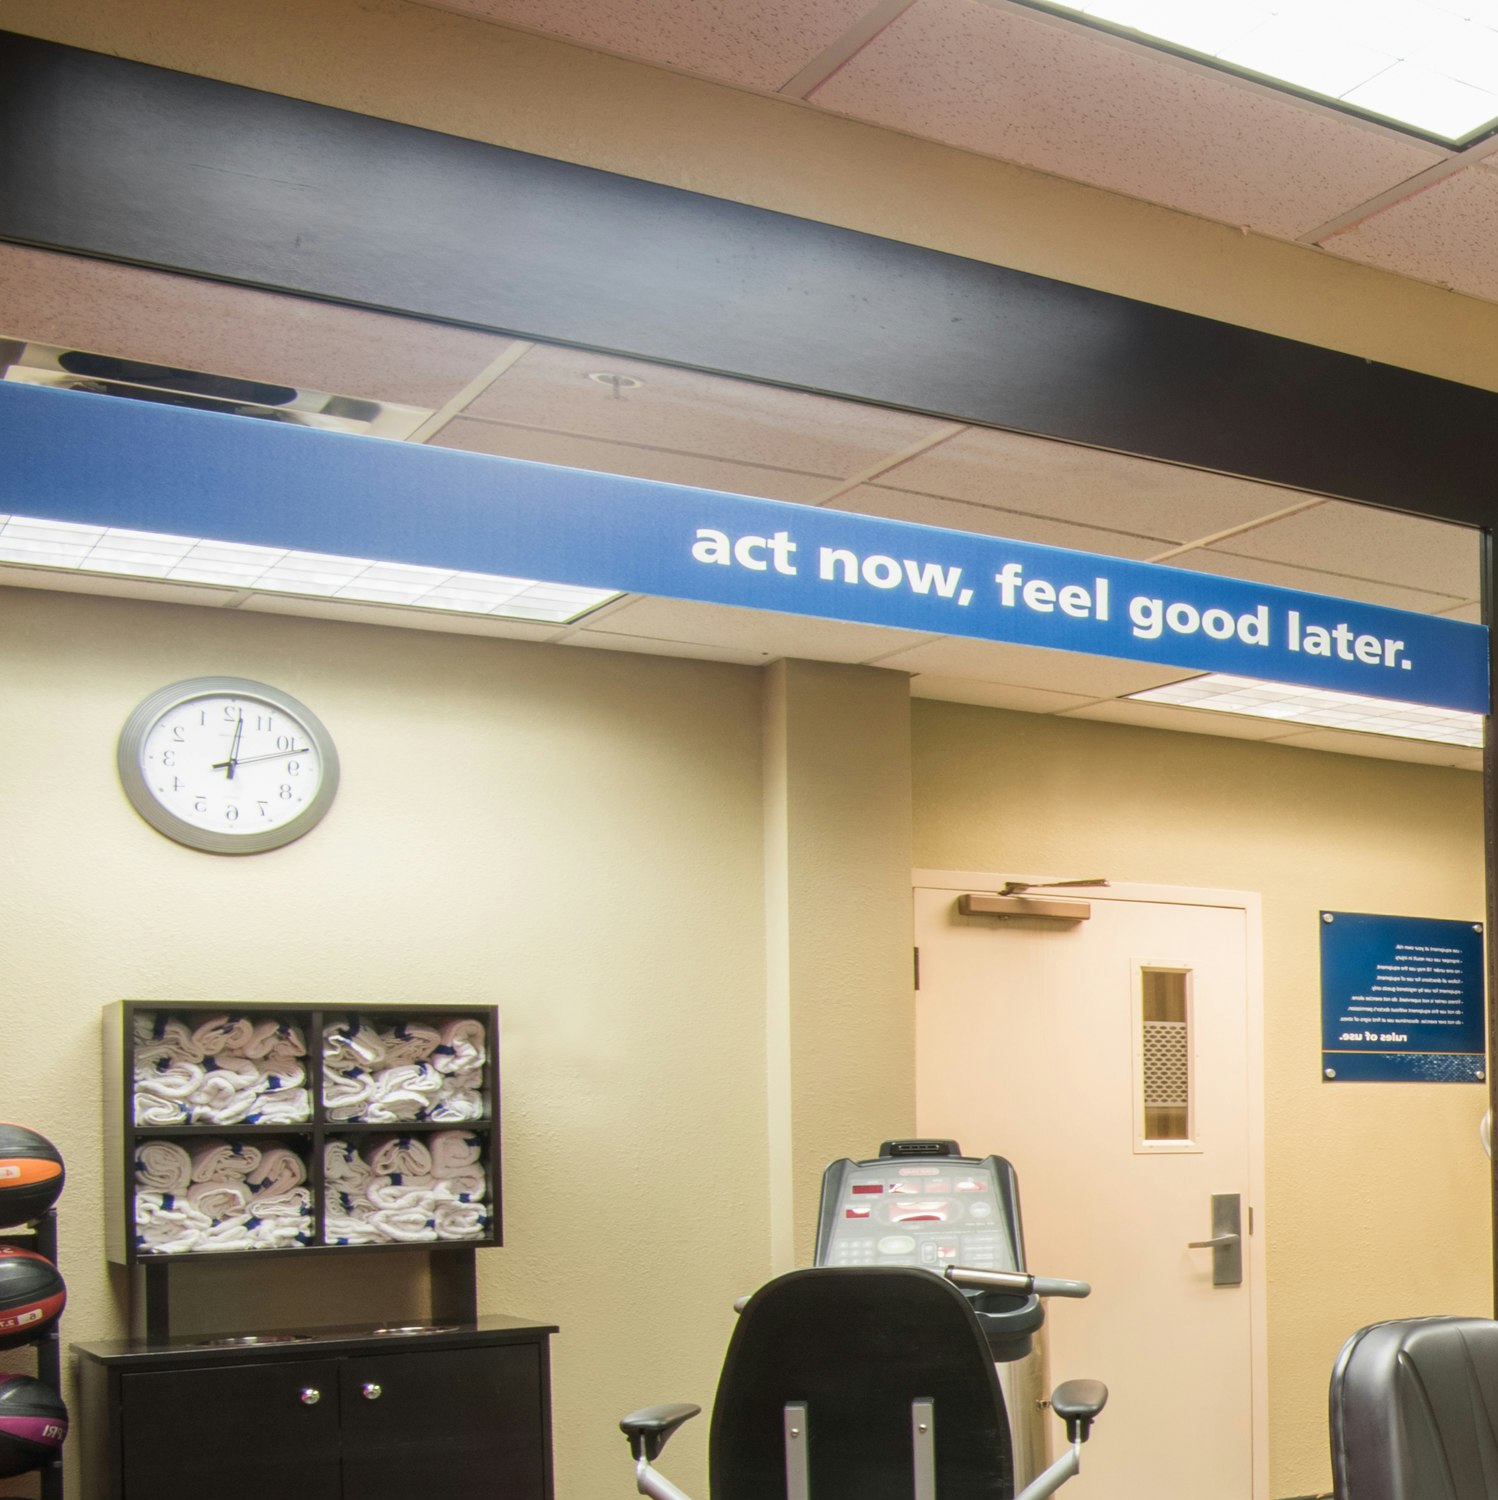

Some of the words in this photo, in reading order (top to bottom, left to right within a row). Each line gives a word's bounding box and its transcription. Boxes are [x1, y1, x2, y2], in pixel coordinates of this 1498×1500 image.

[691, 528, 797, 576] act
[819, 546, 974, 607] now,
[995, 563, 1109, 621] feel
[1128, 594, 1269, 648] good
[1288, 610, 1412, 670] later.
